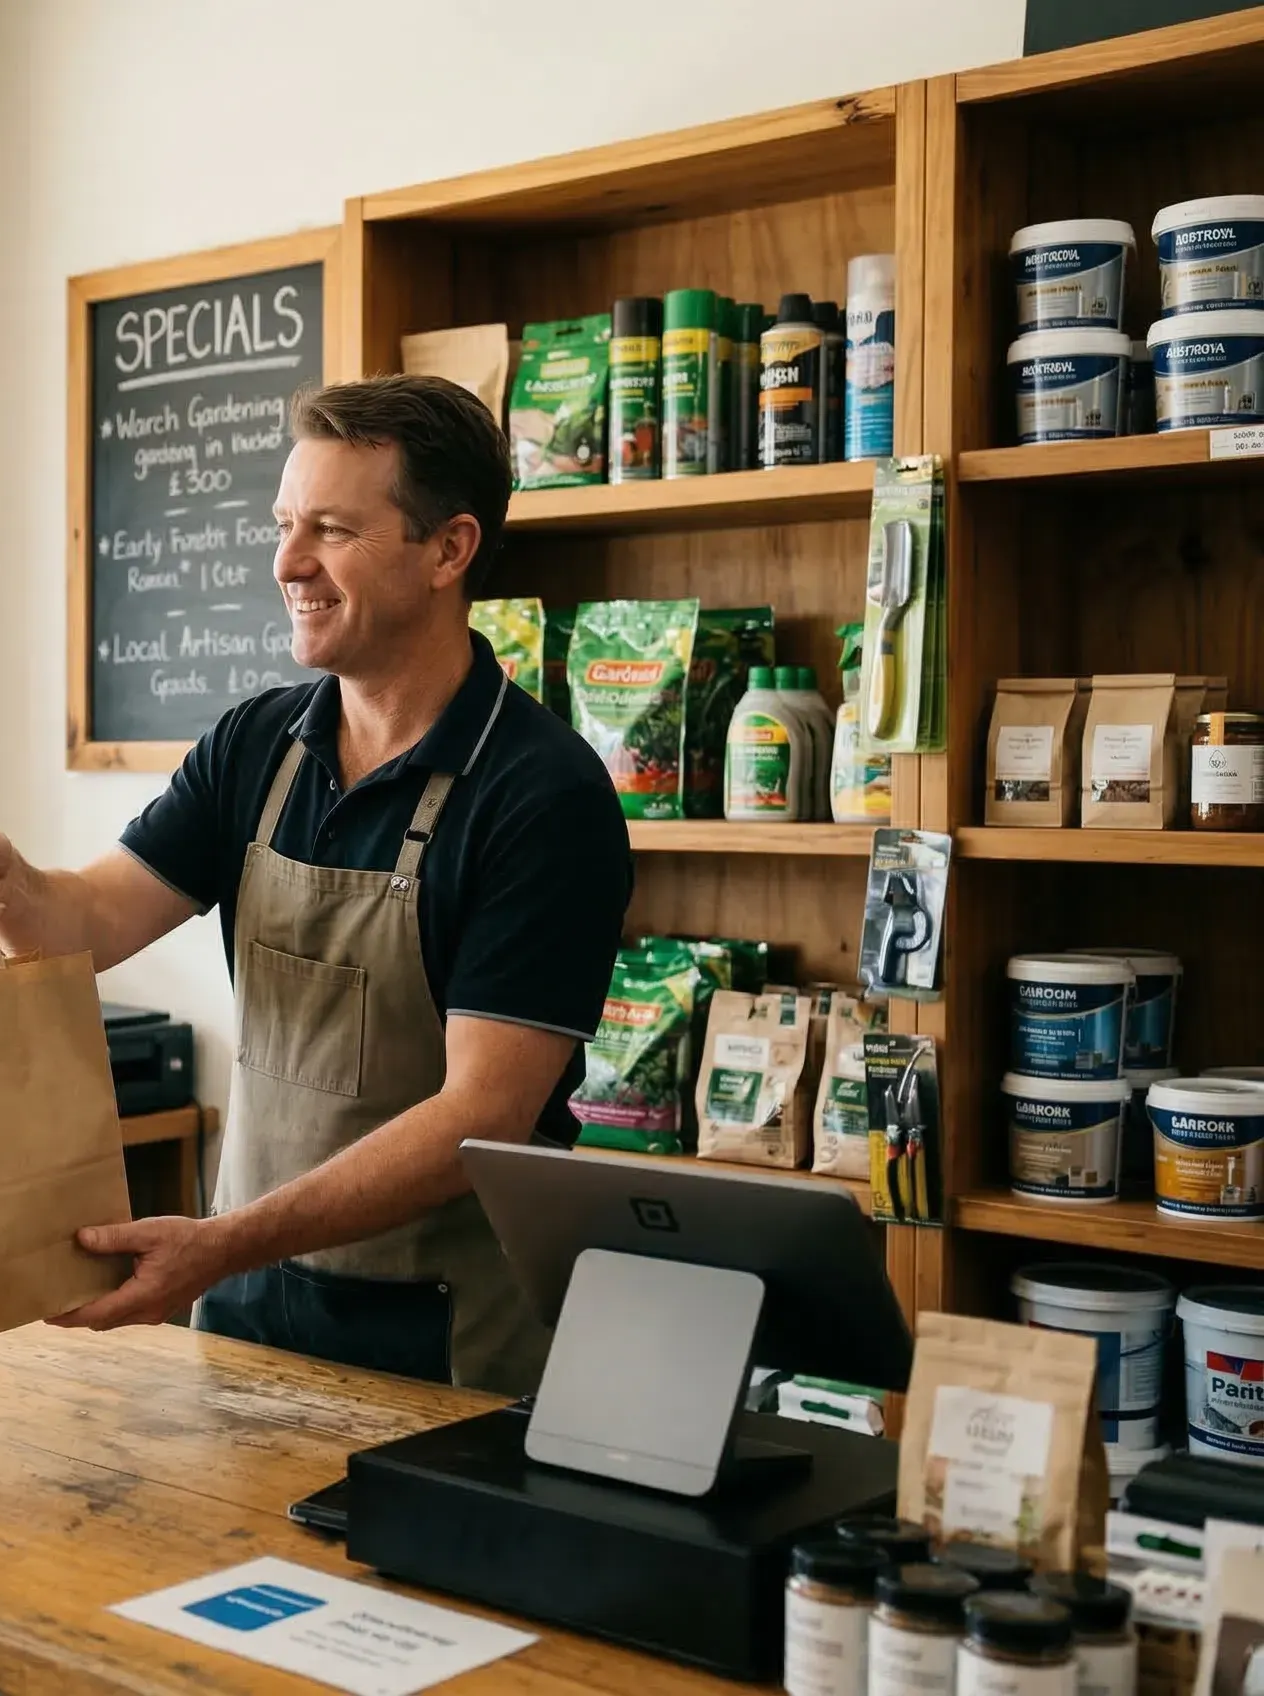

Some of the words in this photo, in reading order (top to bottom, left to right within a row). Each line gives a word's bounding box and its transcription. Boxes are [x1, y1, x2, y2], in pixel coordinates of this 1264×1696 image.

[115, 286, 303, 373] SPECIALS
[188, 393, 285, 435] Gardening
[112, 530, 162, 566] Early
[112, 631, 170, 664] Local
[179, 625, 256, 657] Artisan
